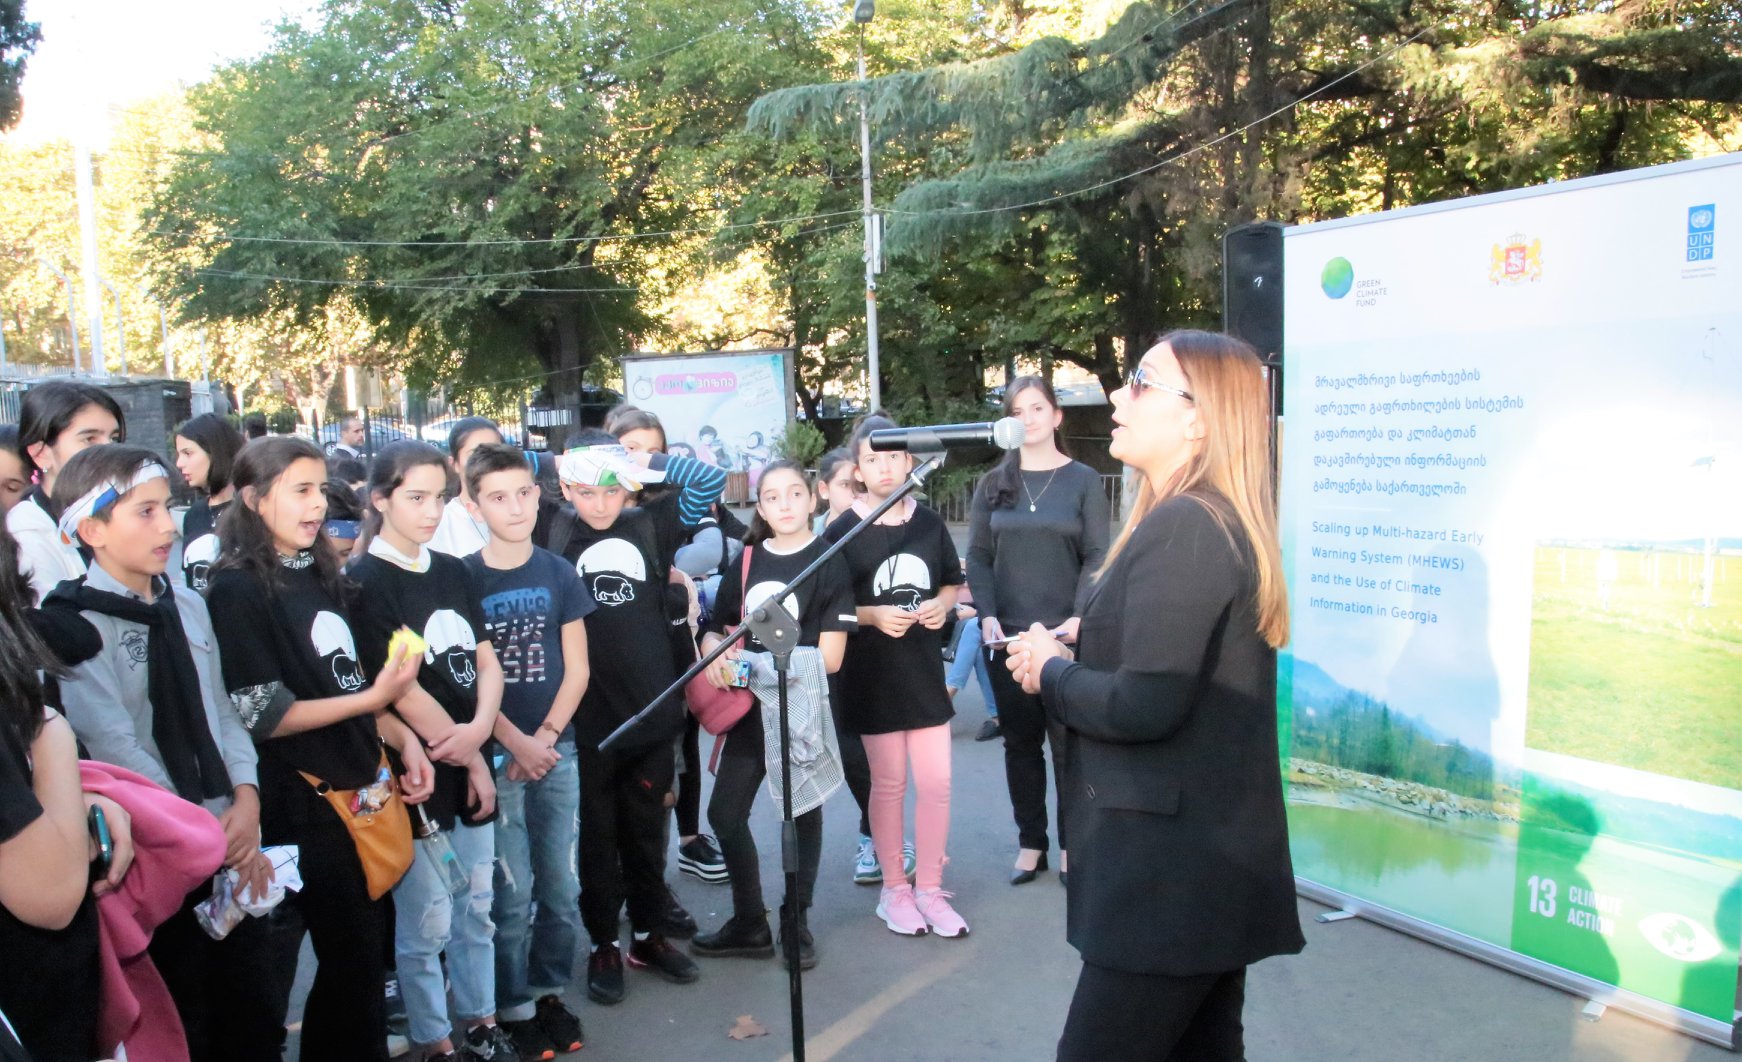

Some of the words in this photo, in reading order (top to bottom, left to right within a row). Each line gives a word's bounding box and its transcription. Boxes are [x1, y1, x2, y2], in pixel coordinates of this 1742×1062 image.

[1356, 279, 1381, 289] GREEN
[1356, 287, 1388, 298] CLIMATE
[1356, 298, 1377, 307] FUND
[1315, 373, 1396, 390] მრავალმხრივი
[1400, 368, 1481, 387] საფრთხეების
[1314, 401, 1367, 416] ადრეული
[1369, 397, 1462, 415] გაფრთხილების
[1465, 395, 1524, 413] სისტემის
[1314, 426, 1384, 442] გაფართოება
[1388, 429, 1402, 441] და
[1406, 424, 1477, 442] კლიმატთან
[1313, 452, 1401, 469] დაკავშირებული
[1404, 453, 1487, 470] ინფორმაციის
[1313, 478, 1373, 494] გამოყენება
[1376, 479, 1467, 497] საქართველოში
[1312, 521, 1351, 537] Scaling
[1355, 526, 1369, 537] up
[1373, 525, 1447, 541] Multi-hazard
[1451, 529, 1484, 546] Early
[1311, 546, 1357, 563] Warning
[1360, 550, 1403, 565] System
[1407, 554, 1465, 571] (MHEWS)
[1310, 572, 1330, 584] and
[1333, 573, 1352, 586] the
[1355, 576, 1377, 589] Use
[1380, 579, 1392, 591] of
[1395, 580, 1442, 596] Climate
[1310, 597, 1373, 615] Information
[1376, 604, 1387, 616] in
[1391, 606, 1438, 624] Georgia
[1528, 875, 1557, 918] 13
[1569, 886, 1623, 917] CLIMATE
[1567, 907, 1615, 937] ACTION
